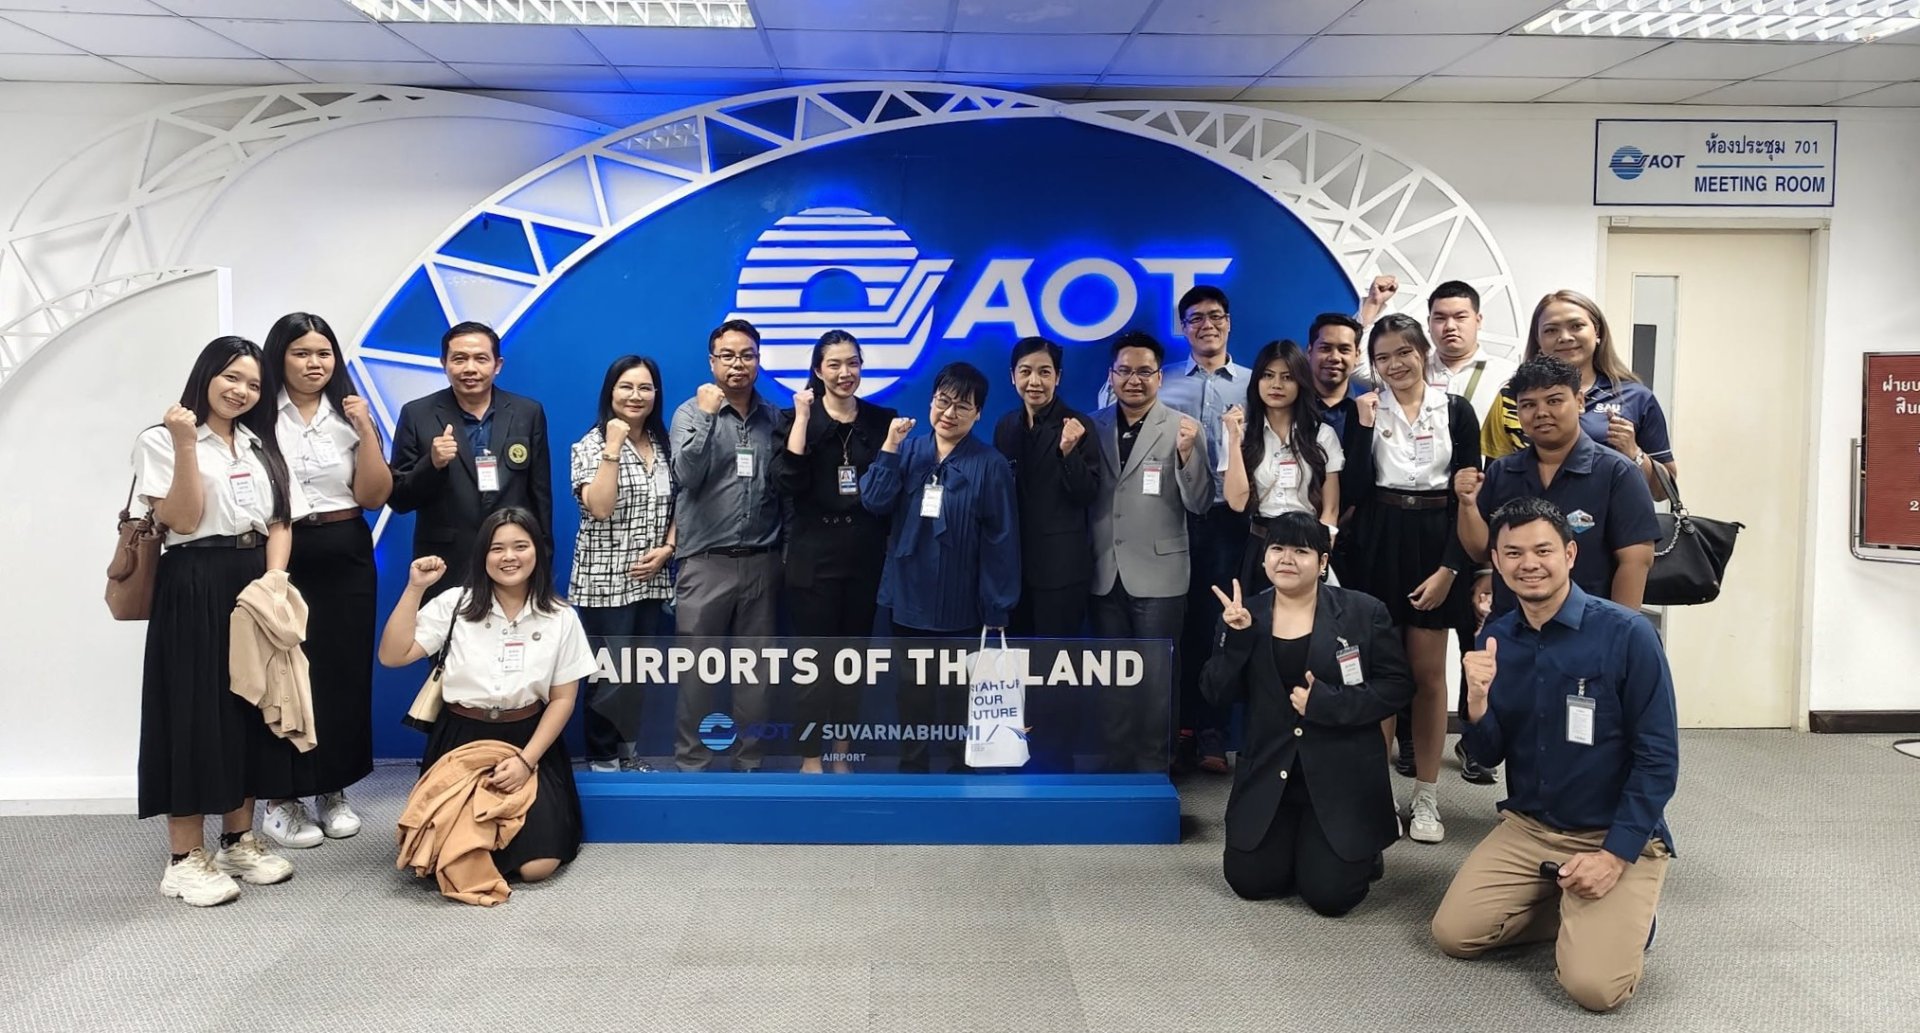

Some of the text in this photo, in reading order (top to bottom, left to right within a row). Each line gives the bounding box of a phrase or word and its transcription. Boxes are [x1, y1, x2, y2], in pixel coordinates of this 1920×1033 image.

[1705, 132, 1819, 161] ห้องประชุม 701
[1648, 154, 1686, 169] AOT
[1694, 175, 1826, 193] MEETING ROOM
[942, 257, 1233, 342] AOT
[1895, 396, 1920, 414] สิน
[588, 647, 1144, 687] AIRPORTS OF THLAND
[971, 694, 1003, 707] OUR
[971, 707, 1018, 720] UTURE
[821, 724, 980, 741] SUVARNABHUMI
[822, 753, 866, 762] AIRPORT
